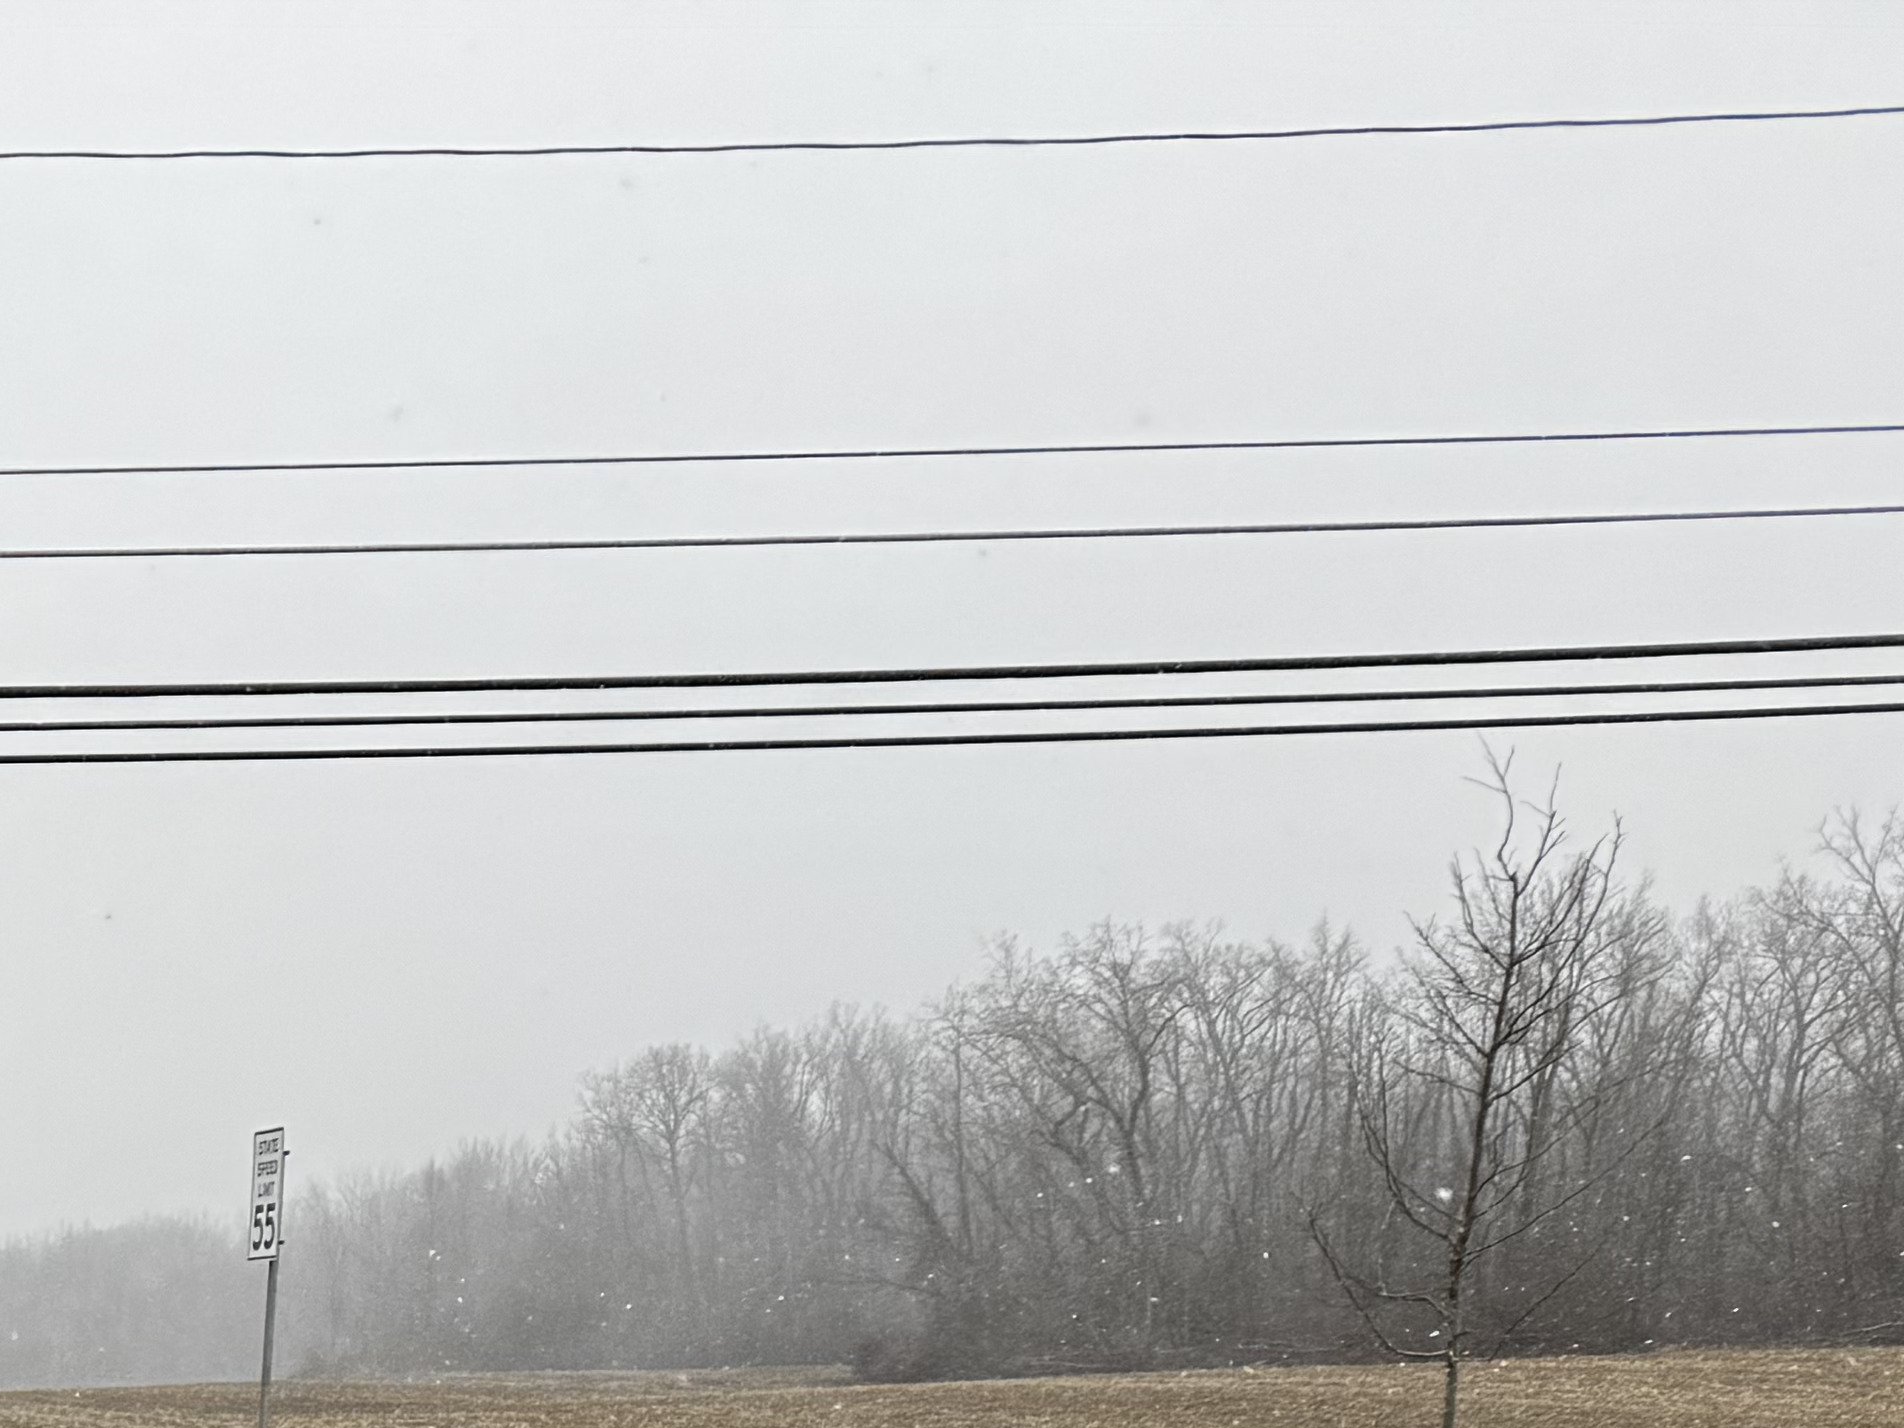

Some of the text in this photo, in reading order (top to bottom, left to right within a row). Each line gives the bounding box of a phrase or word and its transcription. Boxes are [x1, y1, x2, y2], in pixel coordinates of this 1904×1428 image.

[257, 1160, 278, 1177] SPEED
[257, 1181, 275, 1198] LIMIT
[252, 1203, 276, 1251] 55
